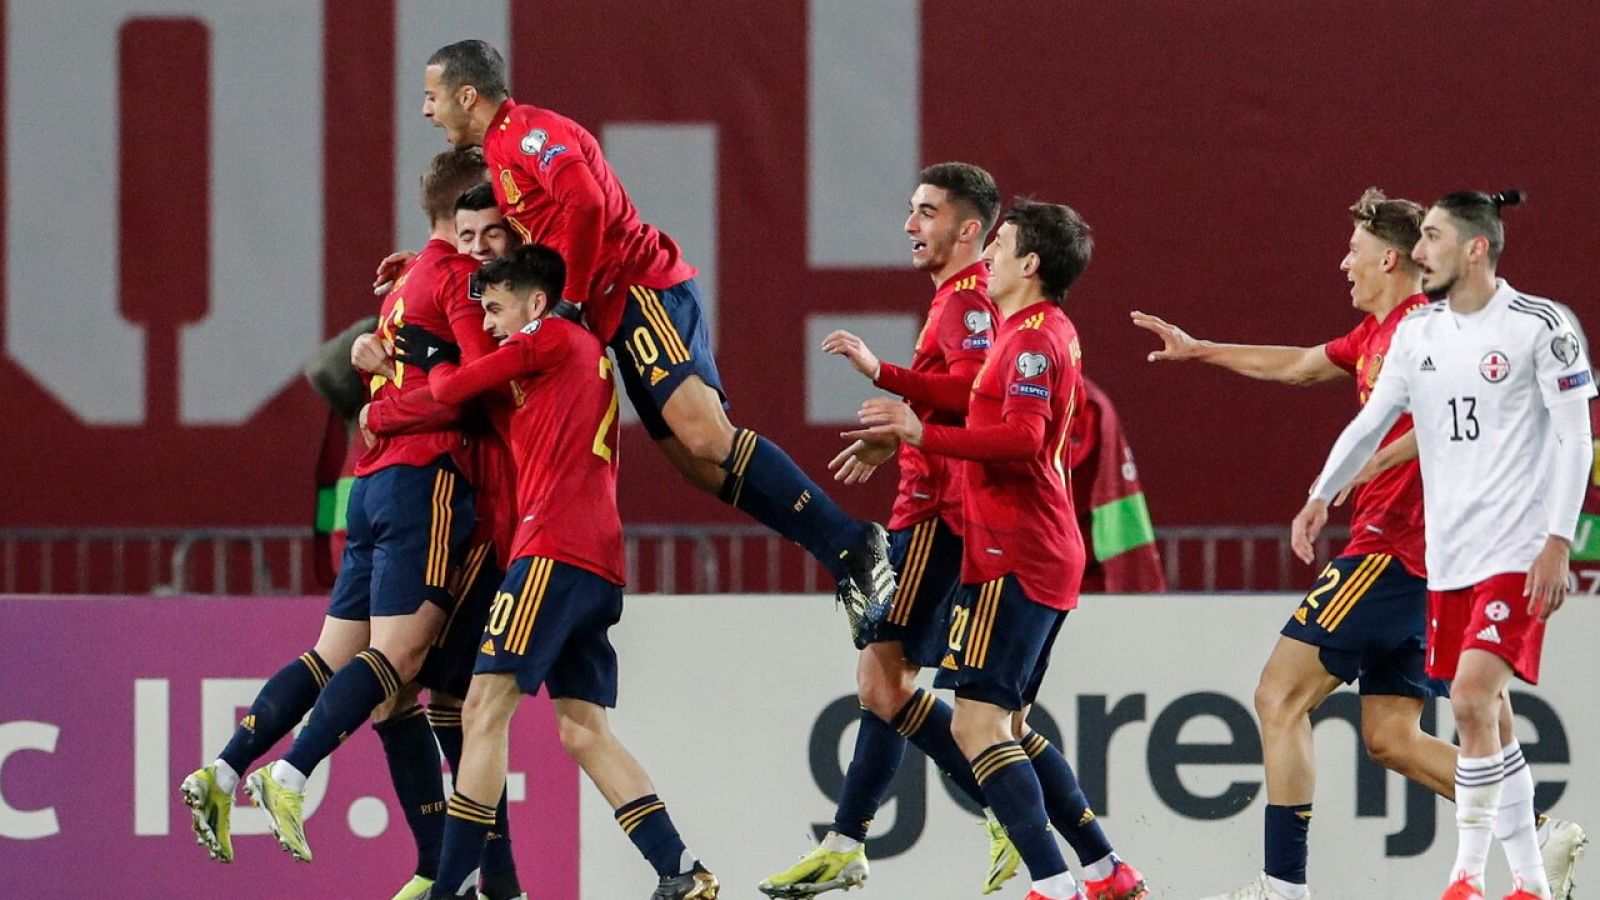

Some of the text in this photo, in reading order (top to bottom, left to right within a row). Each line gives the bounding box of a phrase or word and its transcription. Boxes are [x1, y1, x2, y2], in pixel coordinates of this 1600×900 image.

[1448, 396, 1480, 441] 13
[1306, 561, 1341, 609] 2
[949, 605, 970, 652] 21
[134, 678, 526, 837] ID.
[808, 690, 1570, 861] grenje
